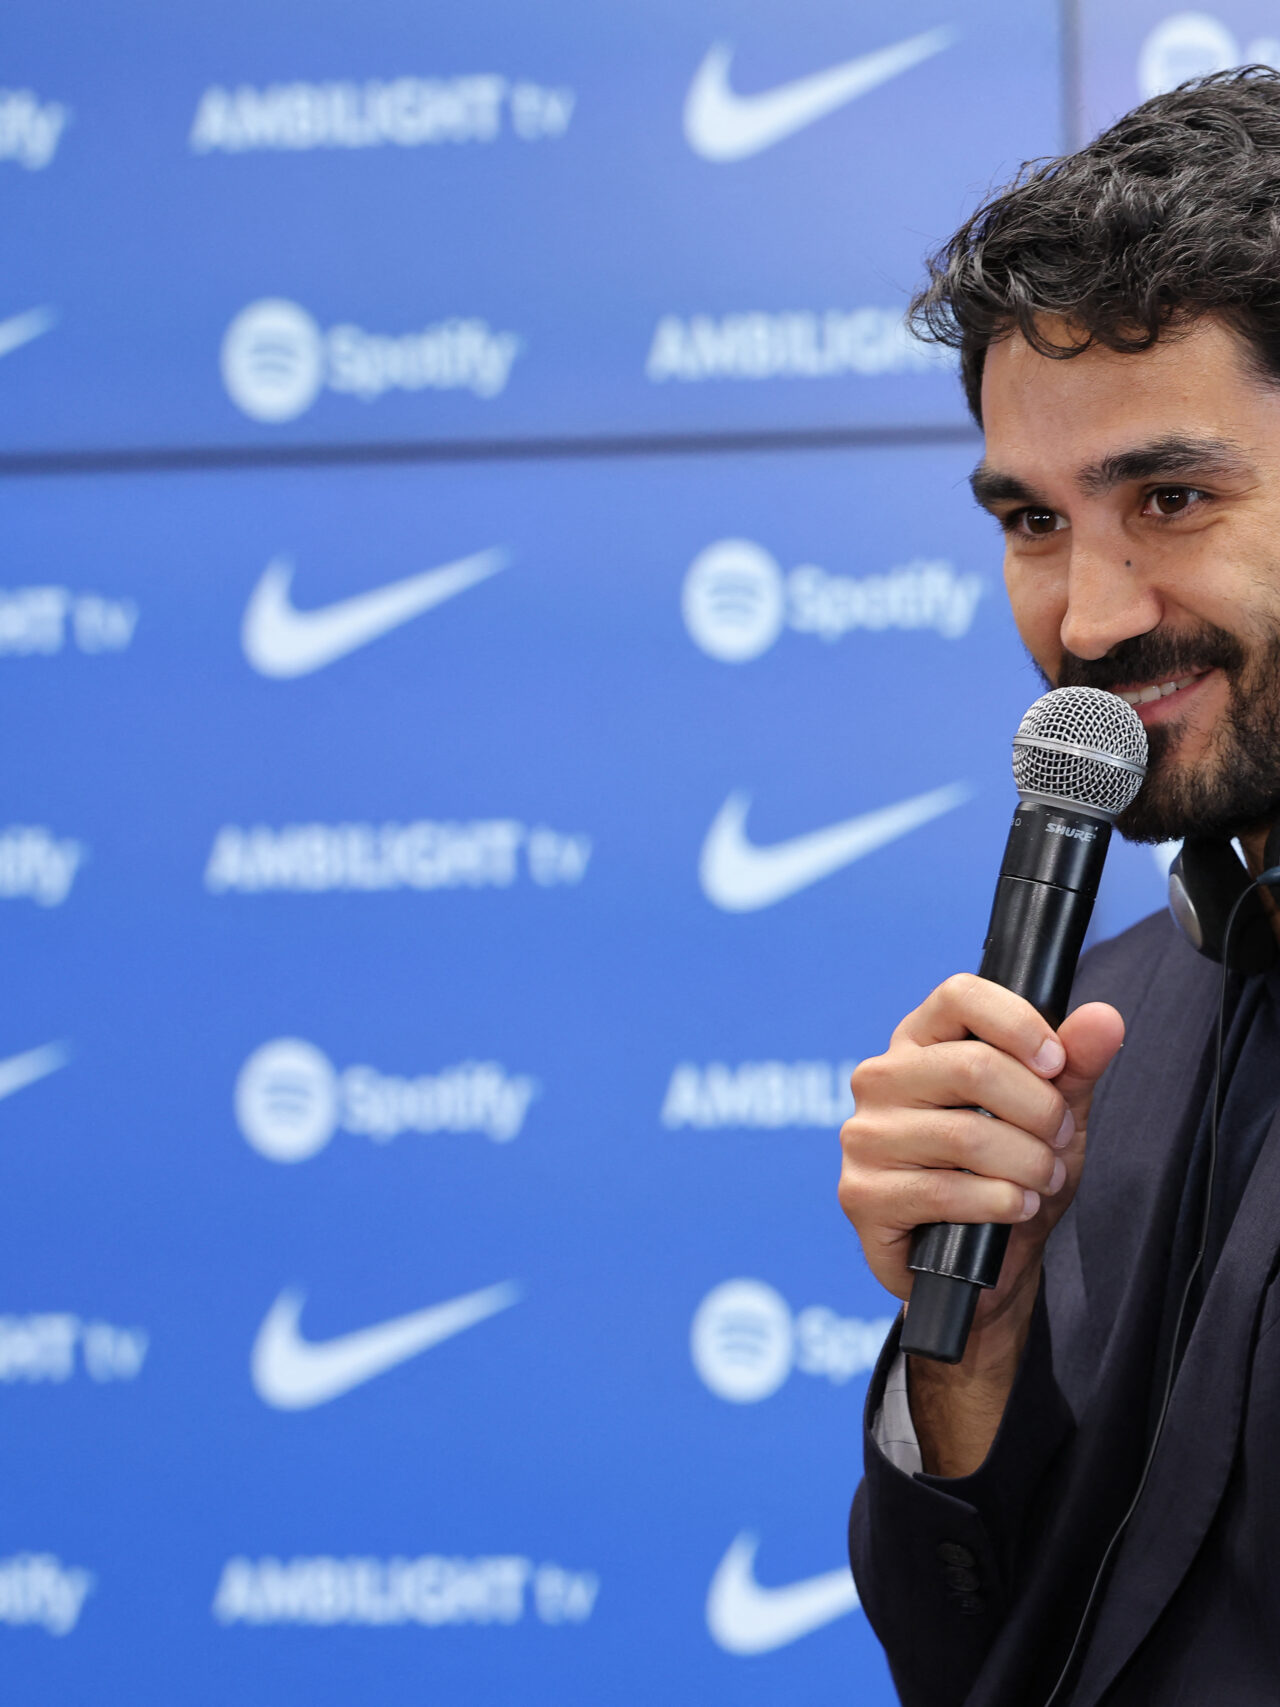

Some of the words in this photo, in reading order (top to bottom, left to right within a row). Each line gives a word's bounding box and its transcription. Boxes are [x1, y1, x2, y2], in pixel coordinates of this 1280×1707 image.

[327, 319, 519, 398] Spotify
[787, 560, 985, 640] Spotify
[1045, 822, 1094, 842] SHURE
[340, 1062, 534, 1142] Spotify
